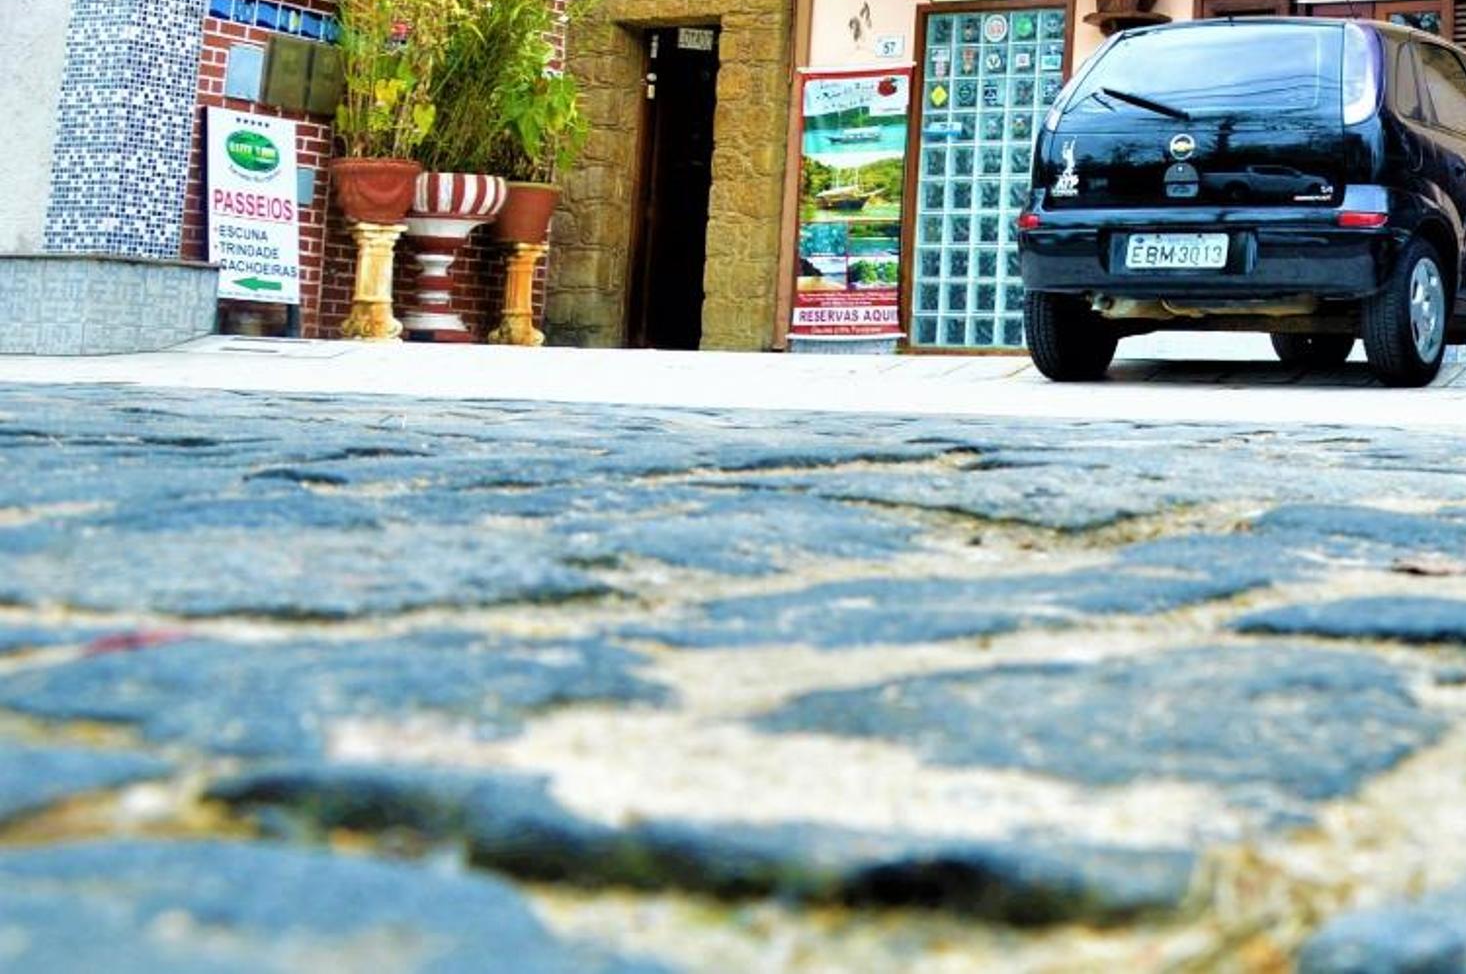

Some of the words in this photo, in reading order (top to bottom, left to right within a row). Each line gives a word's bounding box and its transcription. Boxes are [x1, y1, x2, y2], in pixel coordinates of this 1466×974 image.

[213, 188, 294, 222] PASSEIOS
[219, 224, 269, 243] ESCUNA
[219, 241, 280, 260] TRINDADE
[219, 258, 298, 279] CACHOEIRAS
[799, 309, 859, 323] RESERVAS
